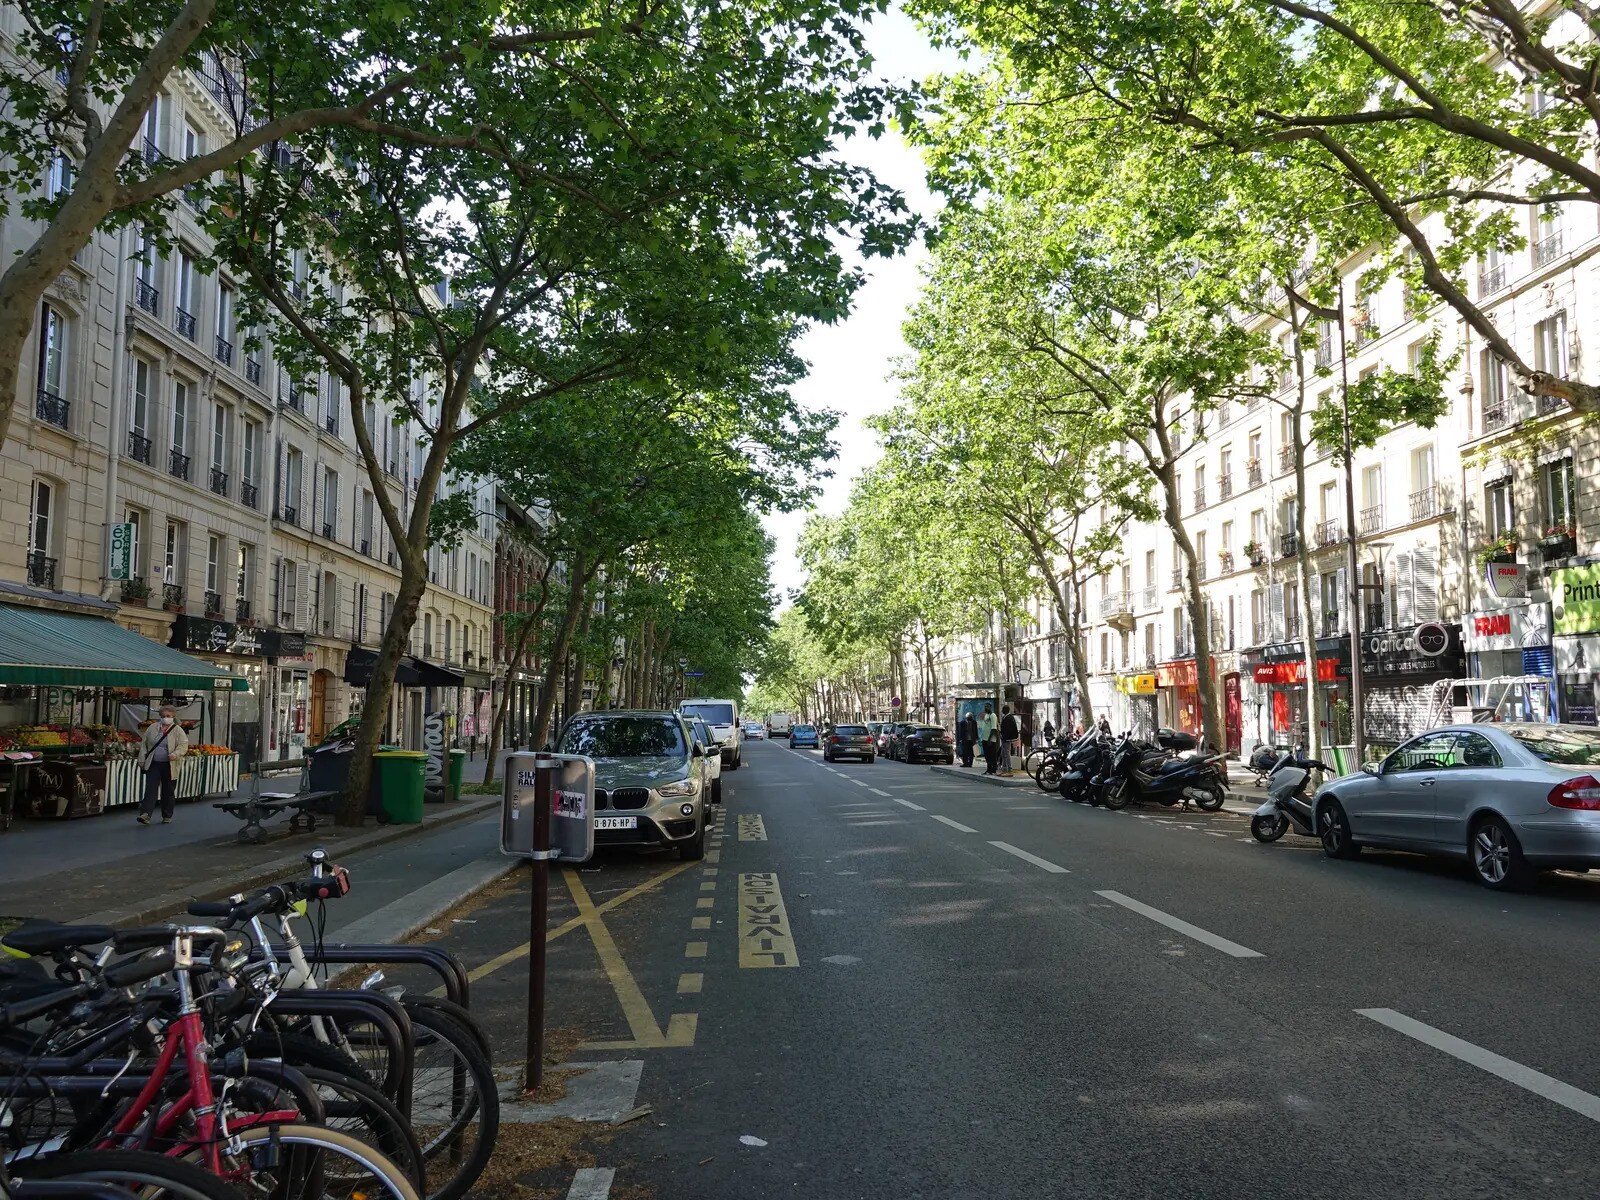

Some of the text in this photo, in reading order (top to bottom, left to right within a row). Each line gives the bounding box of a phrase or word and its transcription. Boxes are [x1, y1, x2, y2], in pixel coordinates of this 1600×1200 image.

[123, 530, 131, 573] SERVICE
[1498, 568, 1517, 576] FRAM
[1475, 613, 1511, 637] FRAM
[1257, 667, 1273, 675] AVIS
[743, 873, 786, 966] LIVRAISON
